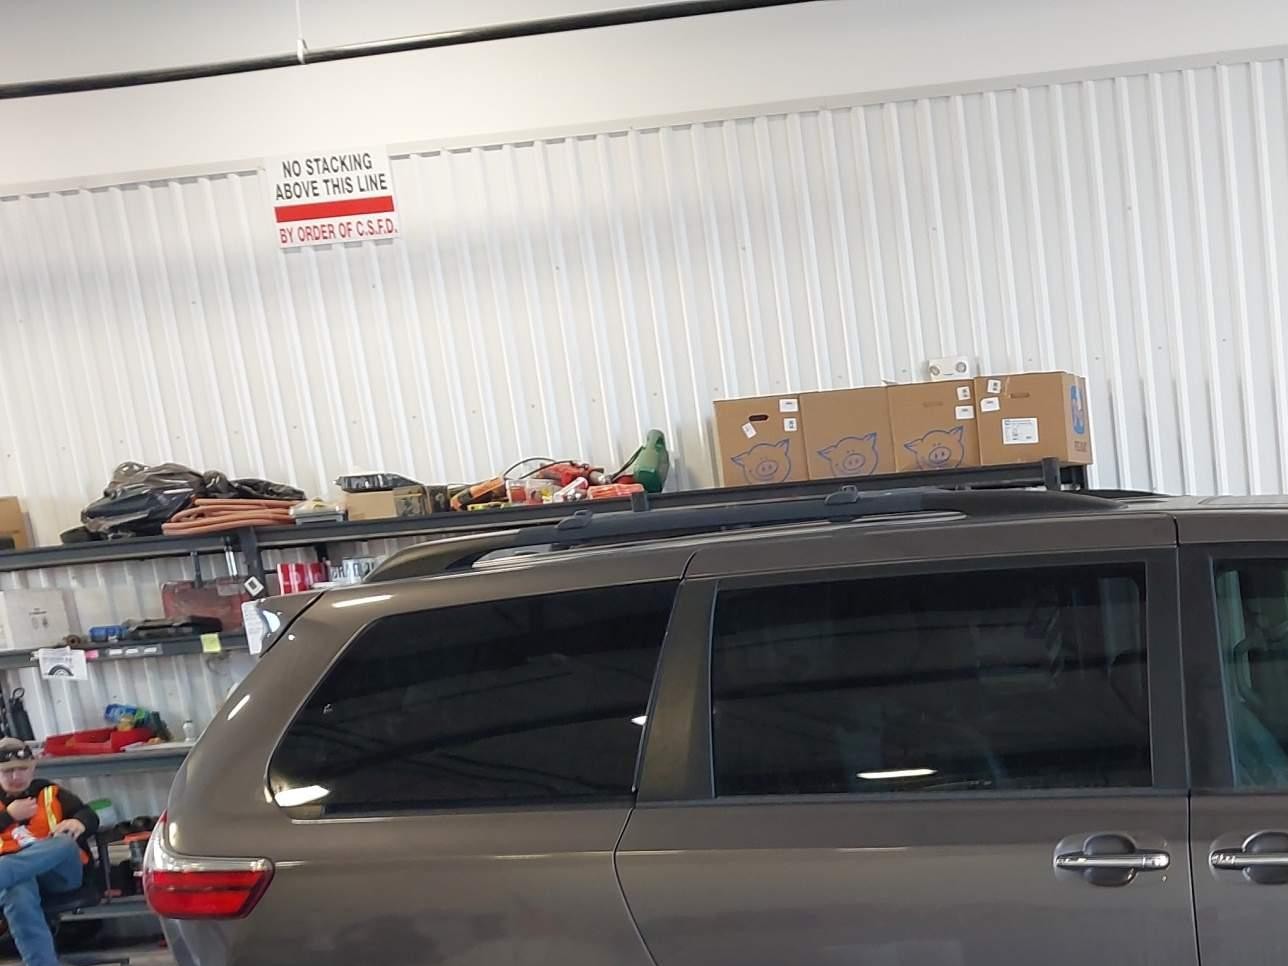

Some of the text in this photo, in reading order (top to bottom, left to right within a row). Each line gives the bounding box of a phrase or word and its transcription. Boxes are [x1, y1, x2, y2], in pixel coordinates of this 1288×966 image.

[282, 153, 371, 178] NO STACKING
[276, 174, 387, 200] ABOVE THIS LINE
[279, 218, 398, 244] BY ORDER OF C.S.F.D.
